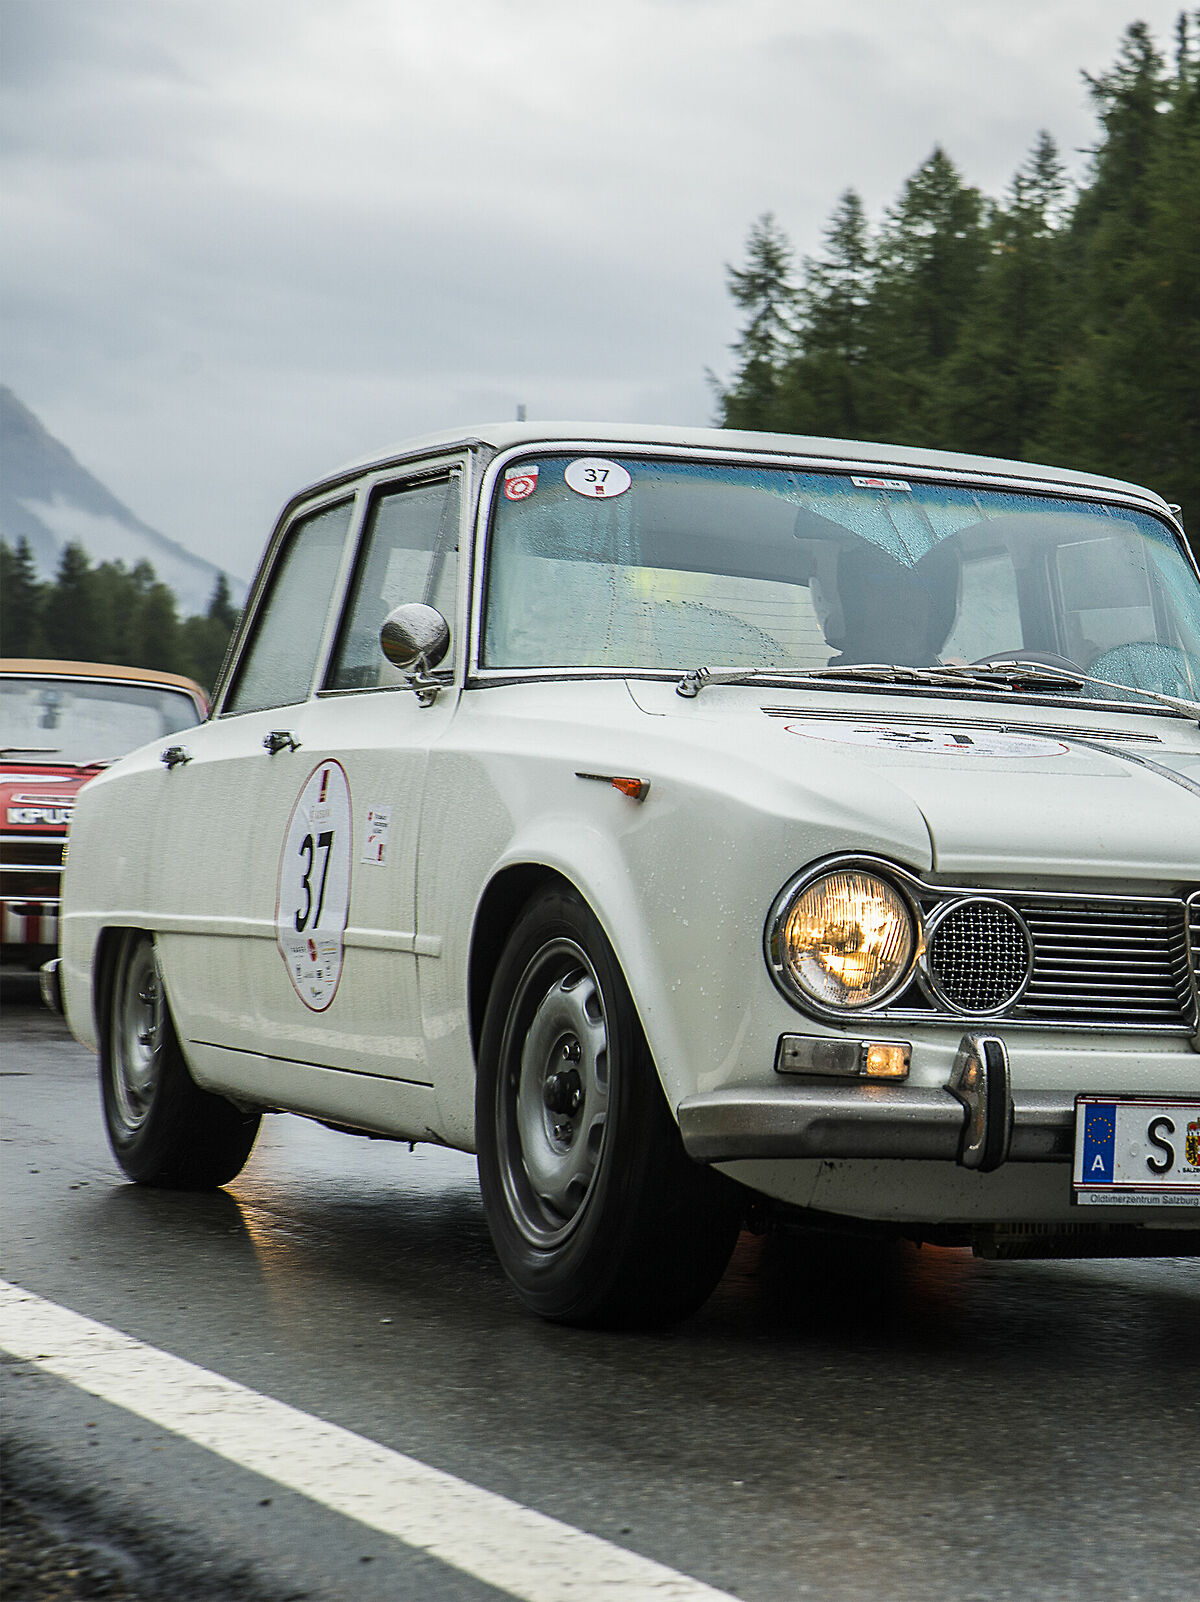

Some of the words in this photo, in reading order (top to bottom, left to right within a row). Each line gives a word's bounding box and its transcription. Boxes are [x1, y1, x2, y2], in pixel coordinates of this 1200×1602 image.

[584, 468, 610, 483] 37
[293, 830, 336, 933] 37
[1146, 1115, 1176, 1175] S
[1090, 1154, 1105, 1172] A
[1090, 1194, 1160, 1204] Oldtimerzentrum
[1162, 1195, 1199, 1206] Salzburg
